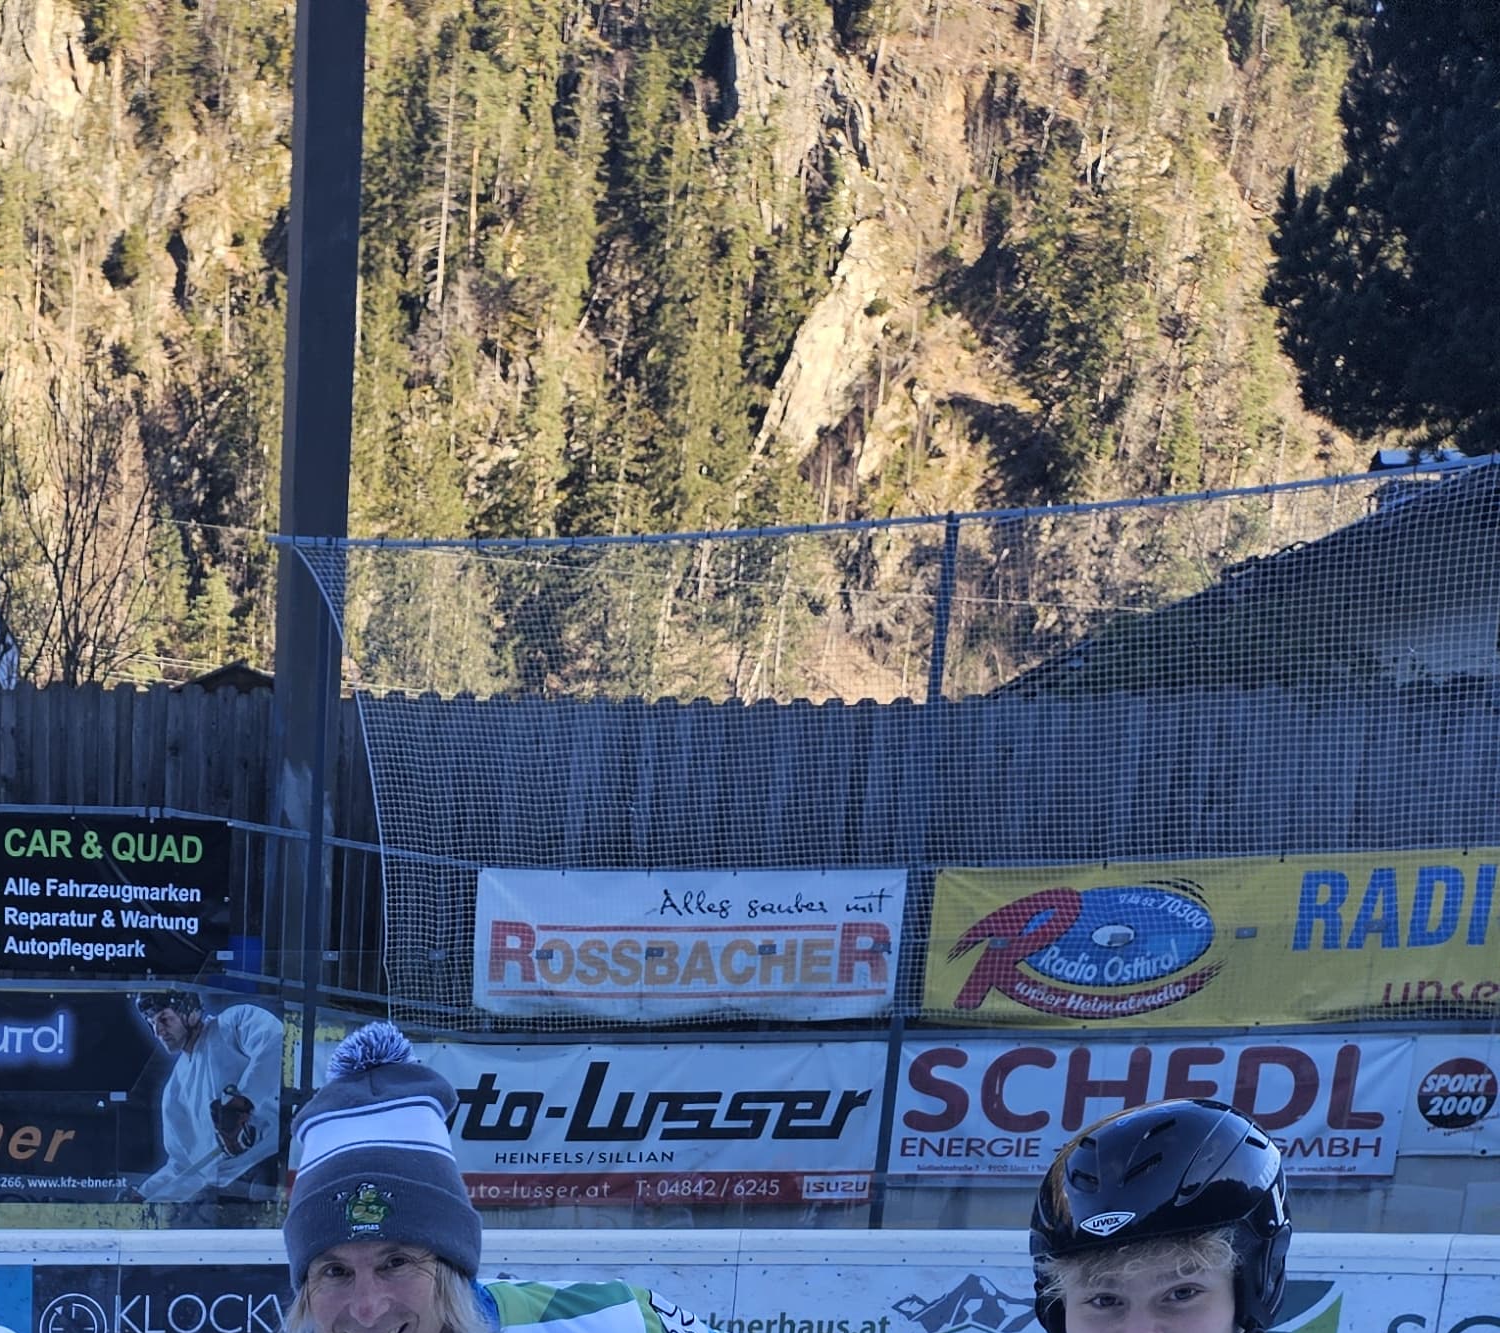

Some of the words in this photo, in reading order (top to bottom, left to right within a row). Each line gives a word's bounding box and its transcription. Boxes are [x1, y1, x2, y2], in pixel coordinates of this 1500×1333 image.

[4, 828, 73, 858] CAR
[81, 831, 104, 860] &
[112, 831, 203, 864] QUAD
[4, 877, 40, 897] Alle
[46, 878, 201, 904] Fahrzeugmarken
[4, 906, 96, 930] Reparatur
[101, 909, 116, 928] &
[120, 910, 199, 935] Wartung
[1157, 895, 1209, 930] 70300
[4, 935, 145, 961] Autopflegepark
[487, 920, 891, 985] ROSSBACHER
[1038, 945, 1097, 981] Radio
[1103, 937, 1181, 982] Osttirol
[903, 1044, 1385, 1134] SCHEDL
[1422, 1074, 1493, 1093] SPORT
[1426, 1095, 1487, 1116] 2000
[900, 1137, 1042, 1158] ENERGIE
[26, 1176, 128, 1189] www.kfz-ebner.at
[656, 1179, 717, 1198] 04842
[733, 1178, 781, 1198] 6245
[804, 1181, 868, 1195] ISUZU
[1091, 1215, 1121, 1229] uvex
